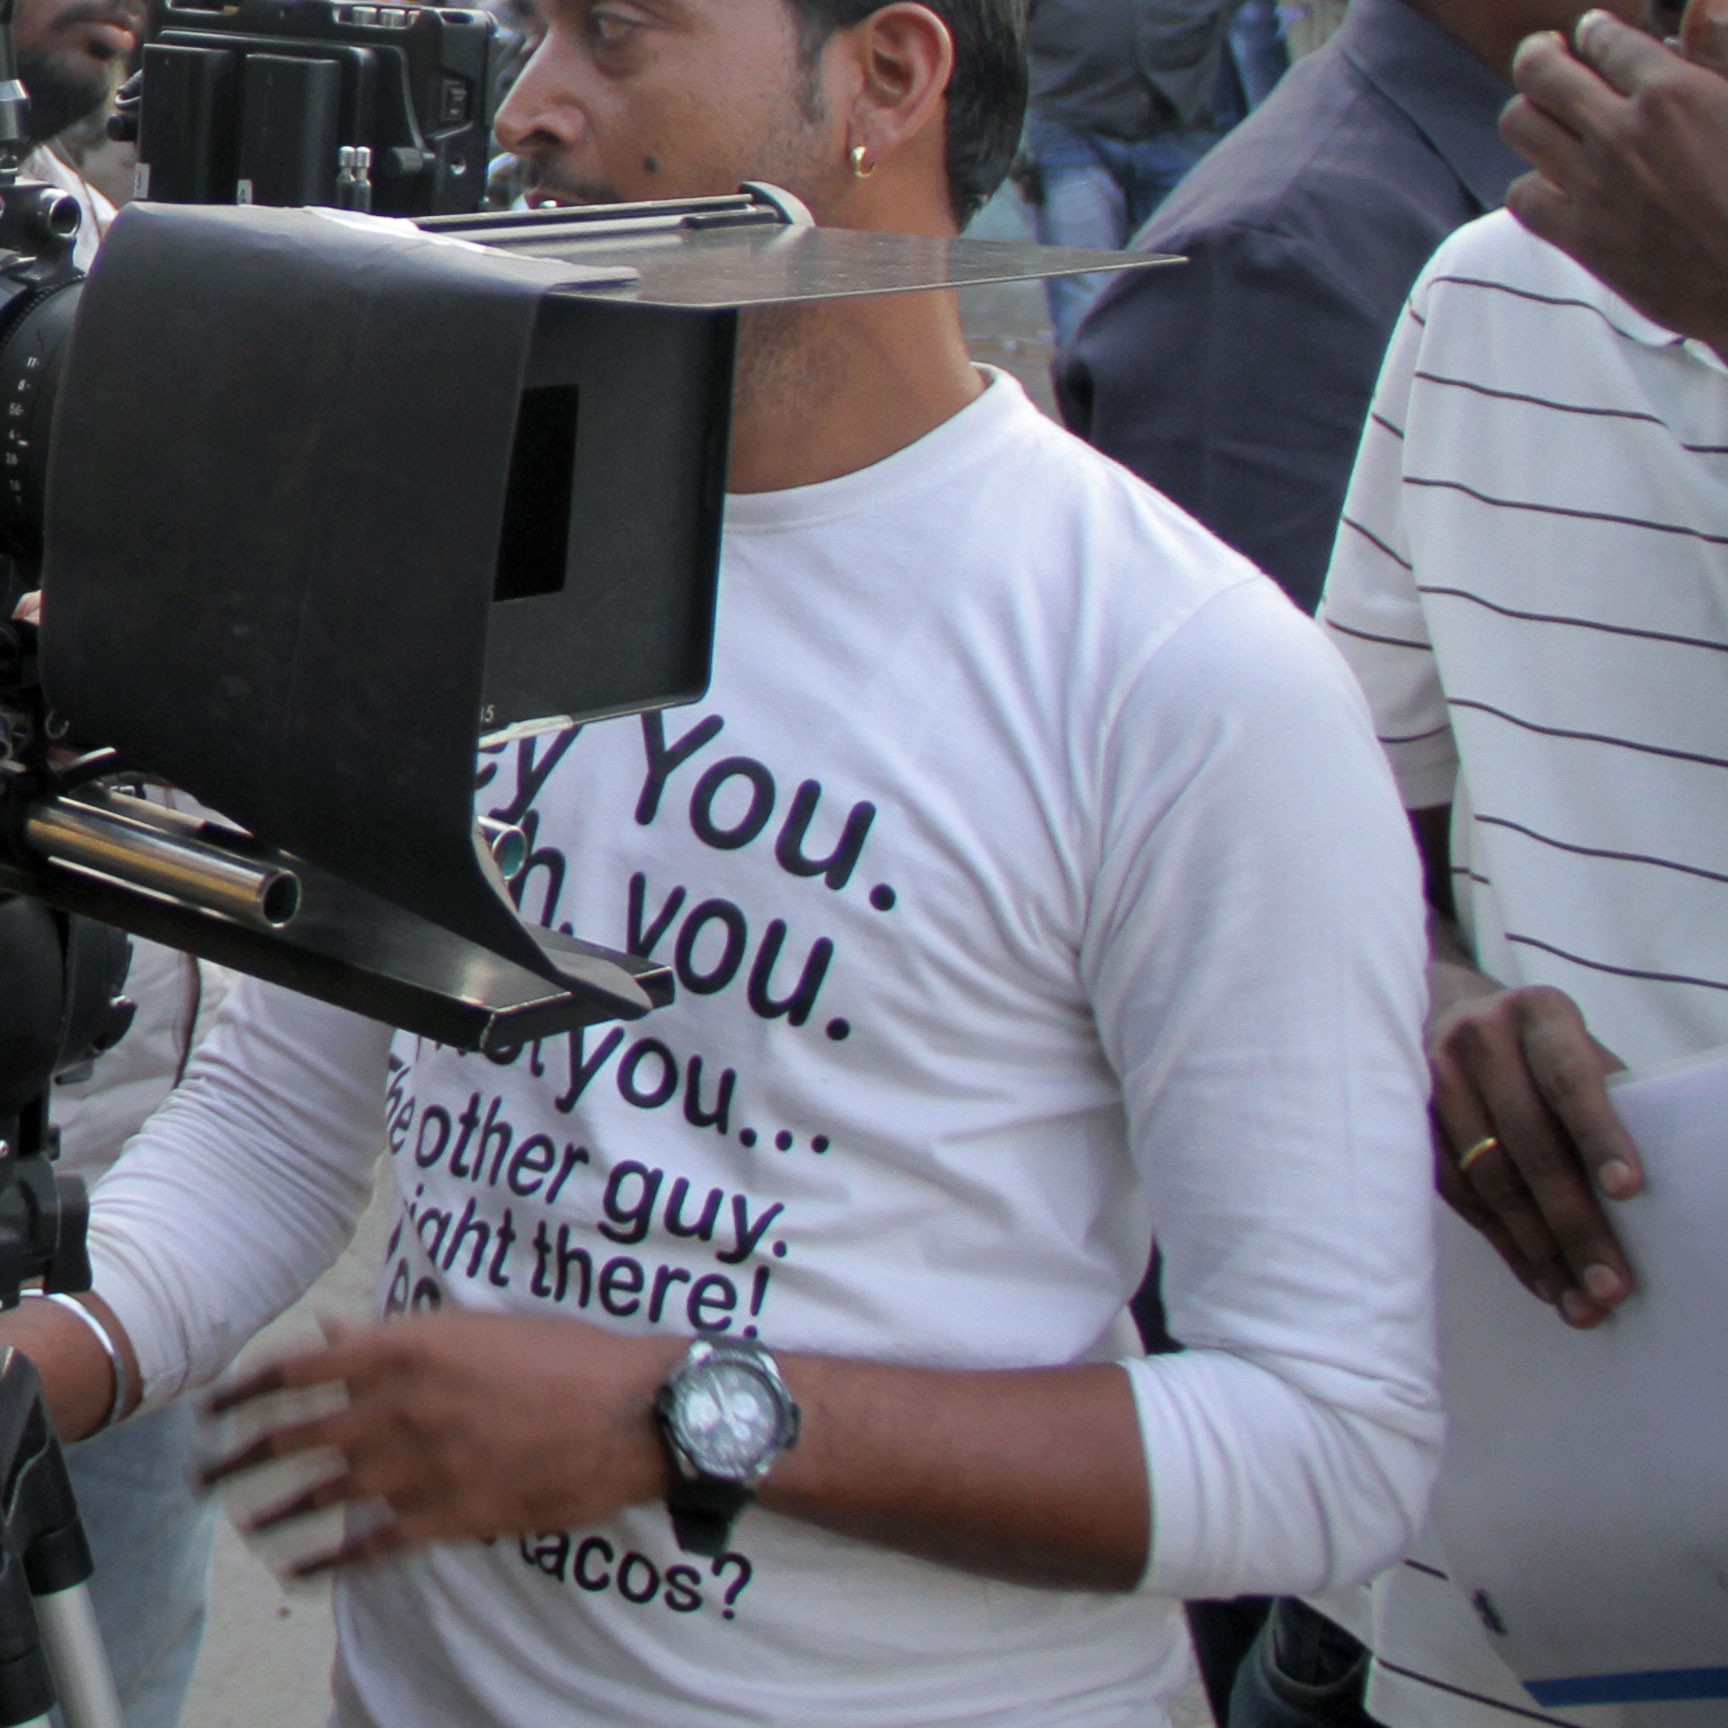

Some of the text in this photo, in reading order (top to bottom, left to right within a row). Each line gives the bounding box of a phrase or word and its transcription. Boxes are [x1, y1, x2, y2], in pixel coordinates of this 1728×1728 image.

[634, 710, 897, 912] You.
[627, 872, 851, 1041] you.
[415, 1090, 590, 1205] other
[597, 1158, 789, 1265] guy.
[530, 1218, 771, 1338] there!
